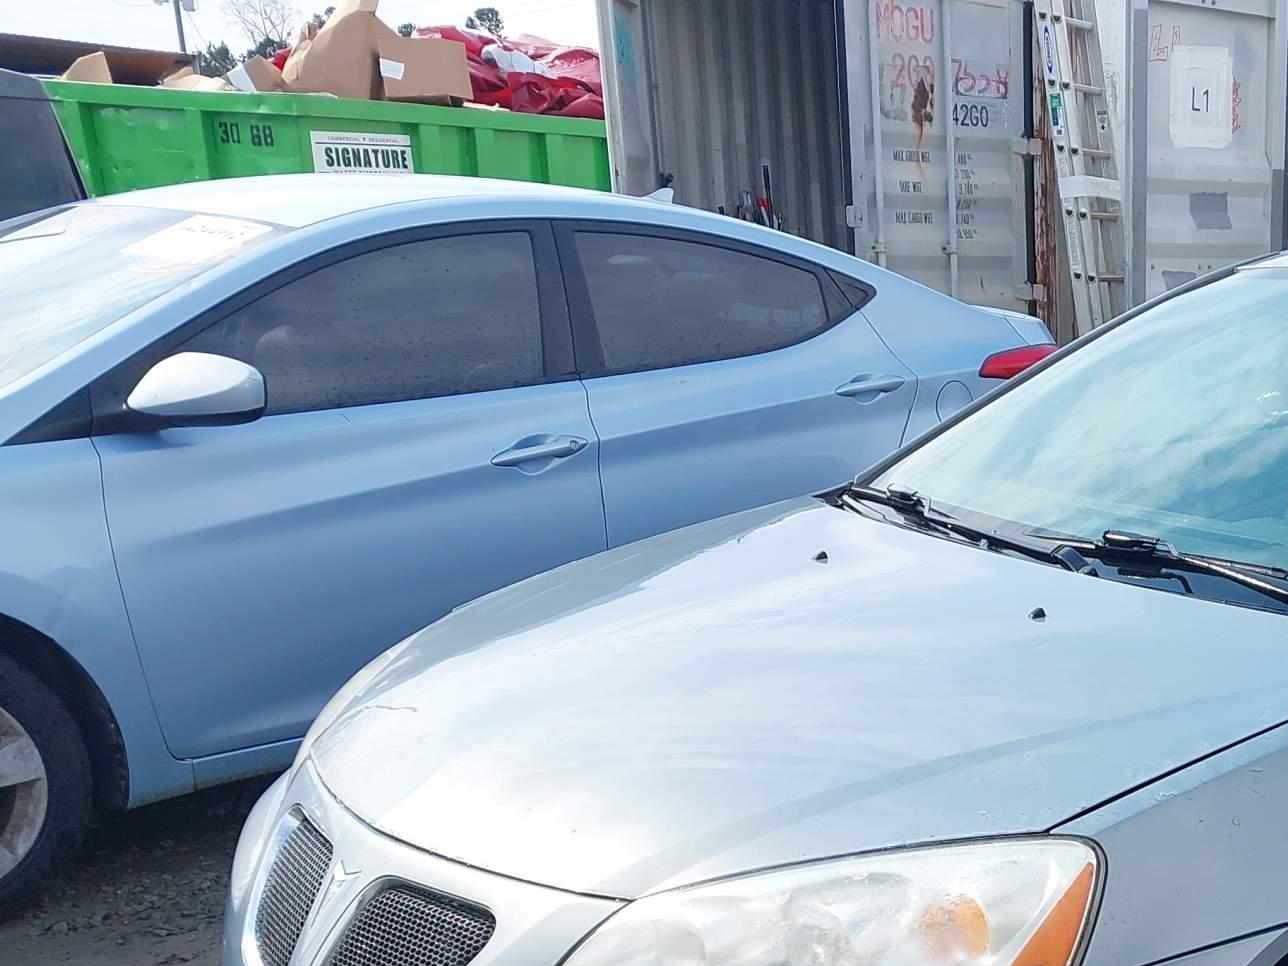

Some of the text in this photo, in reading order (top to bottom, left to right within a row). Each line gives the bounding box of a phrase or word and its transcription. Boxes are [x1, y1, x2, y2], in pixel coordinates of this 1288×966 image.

[1191, 86, 1209, 113] L1
[218, 121, 241, 144] 30
[327, 135, 361, 143] COMMERCIAL
[323, 146, 409, 169] SIGNATURE
